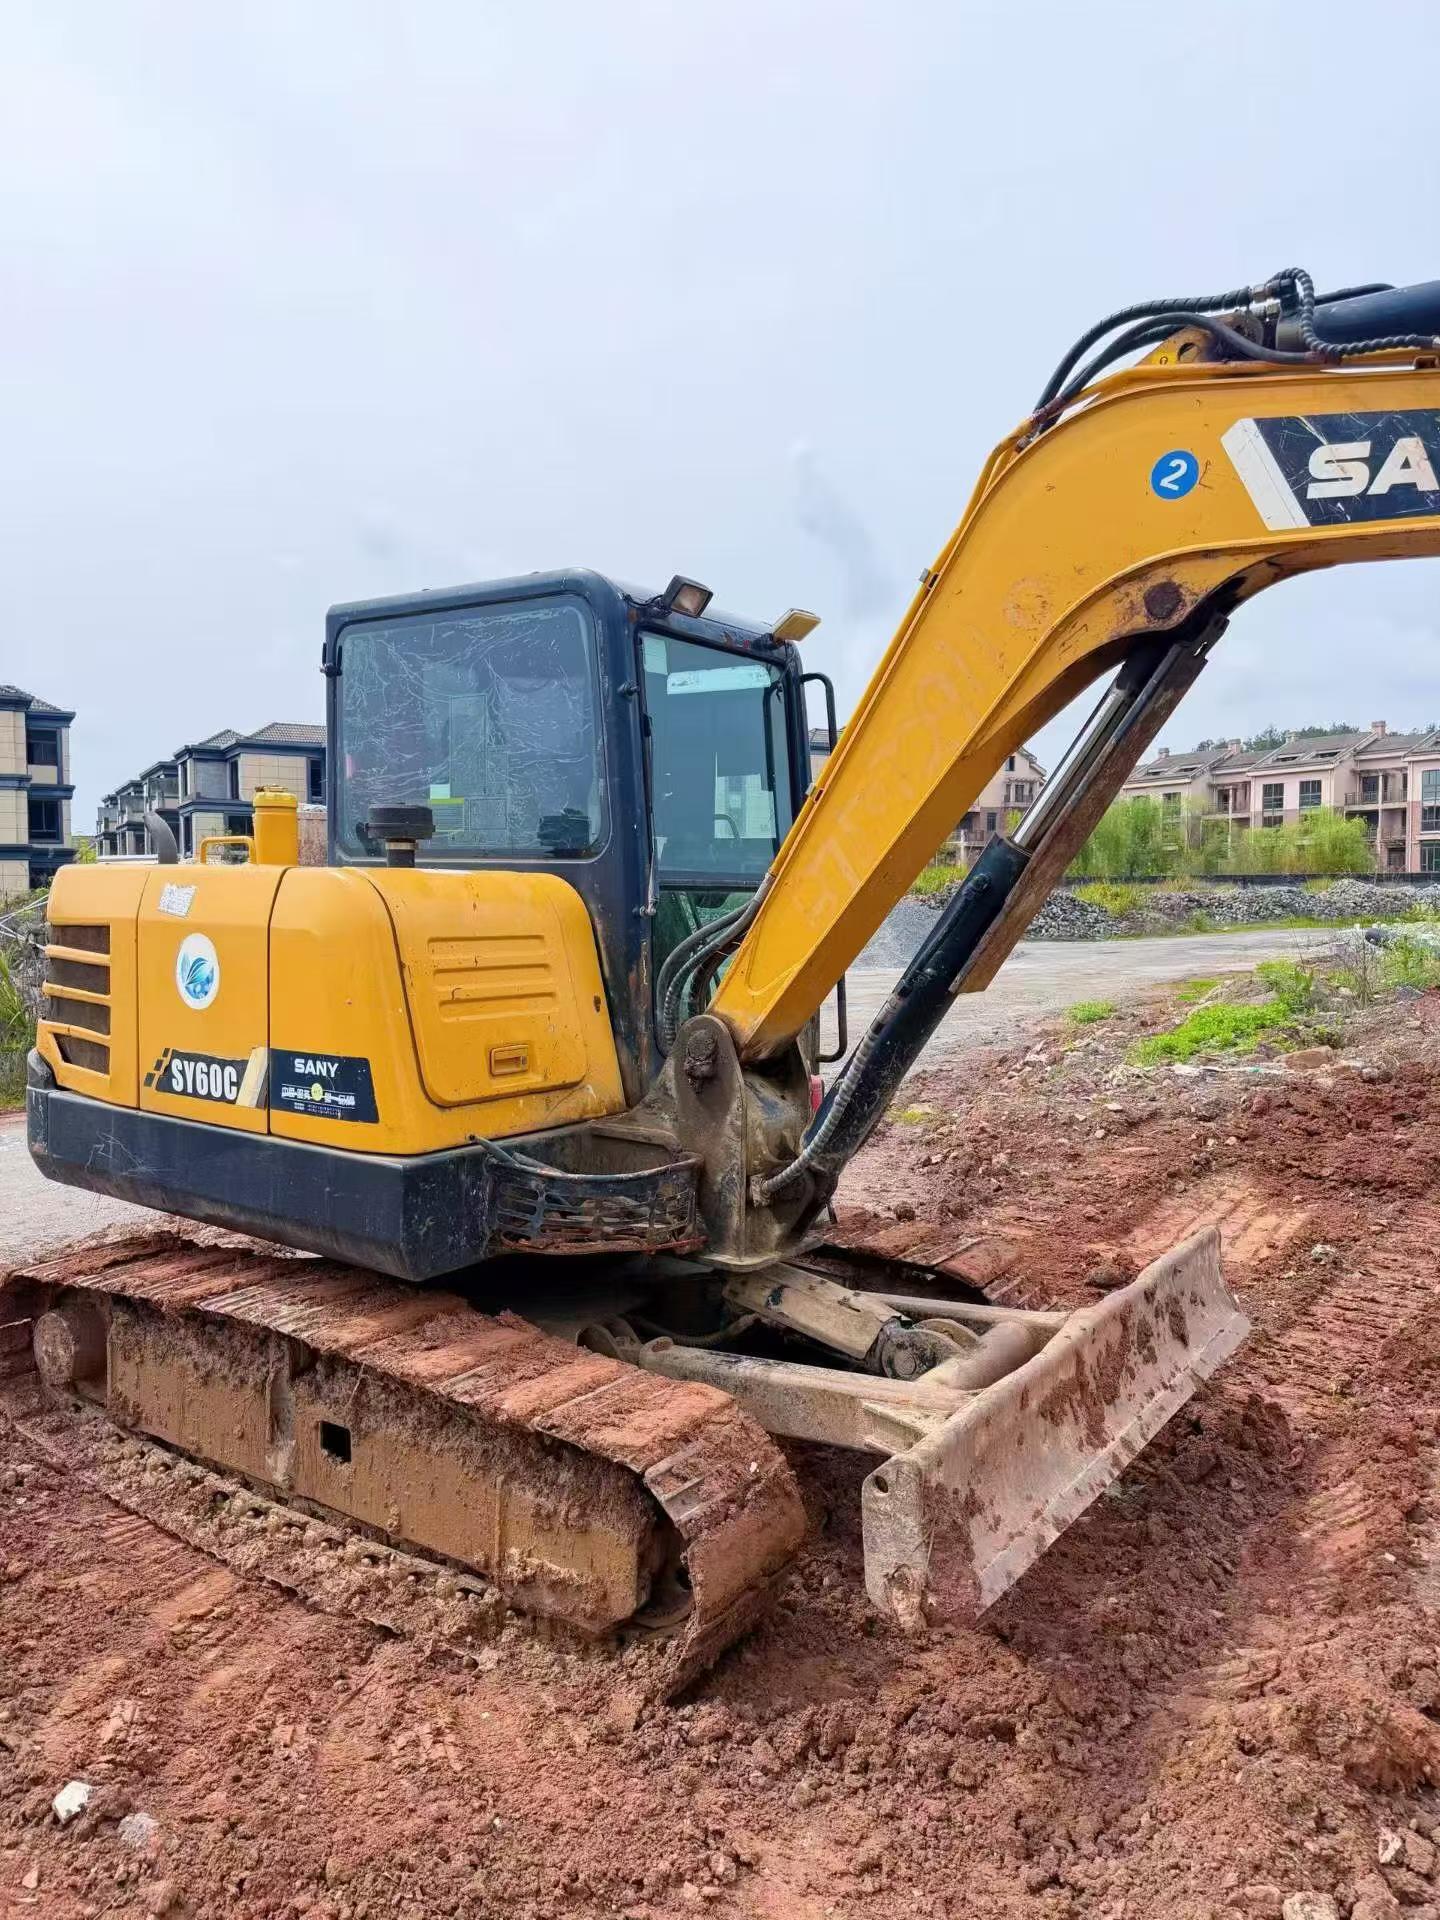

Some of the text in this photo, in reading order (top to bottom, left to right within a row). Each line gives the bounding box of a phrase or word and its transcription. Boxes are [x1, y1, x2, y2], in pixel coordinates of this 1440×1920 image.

[1159, 458, 1188, 491] 2
[170, 1058, 238, 1101] SY60C
[294, 1058, 340, 1078] SANY
